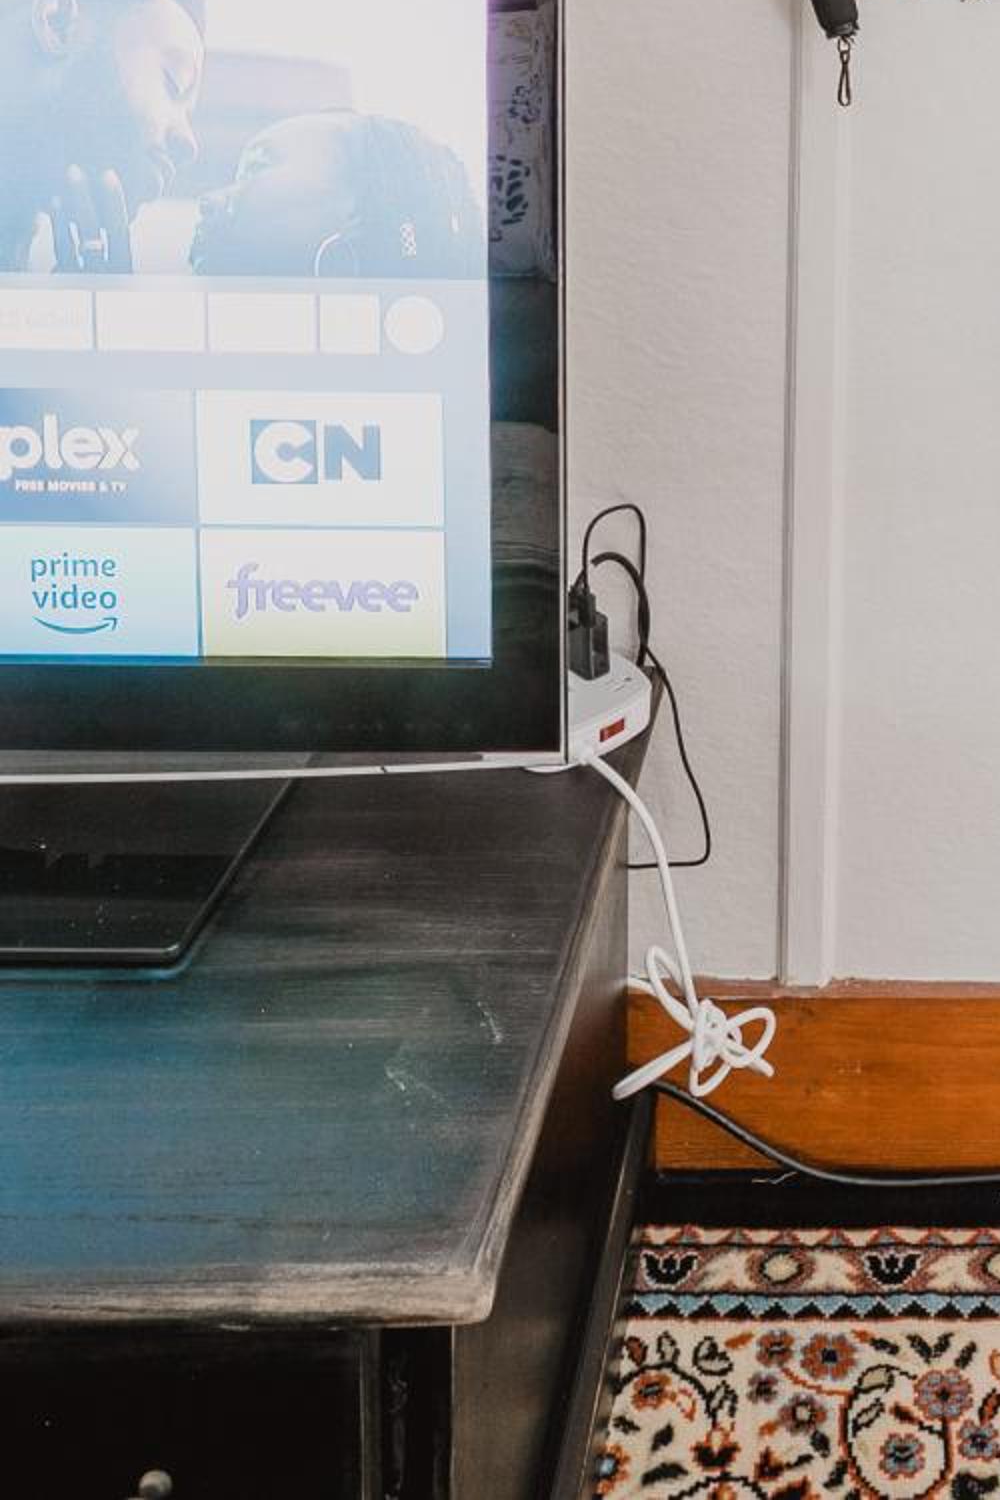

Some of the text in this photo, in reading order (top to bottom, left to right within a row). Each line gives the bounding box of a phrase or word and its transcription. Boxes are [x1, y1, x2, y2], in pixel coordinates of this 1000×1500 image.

[0, 413, 141, 481] plex
[250, 419, 381, 484] CN
[15, 479, 45, 492] FREE
[47, 479, 97, 492] MOVIES
[111, 481, 128, 492] TV
[31, 553, 117, 583] prime
[32, 584, 117, 609] video
[227, 562, 419, 619] freevee
